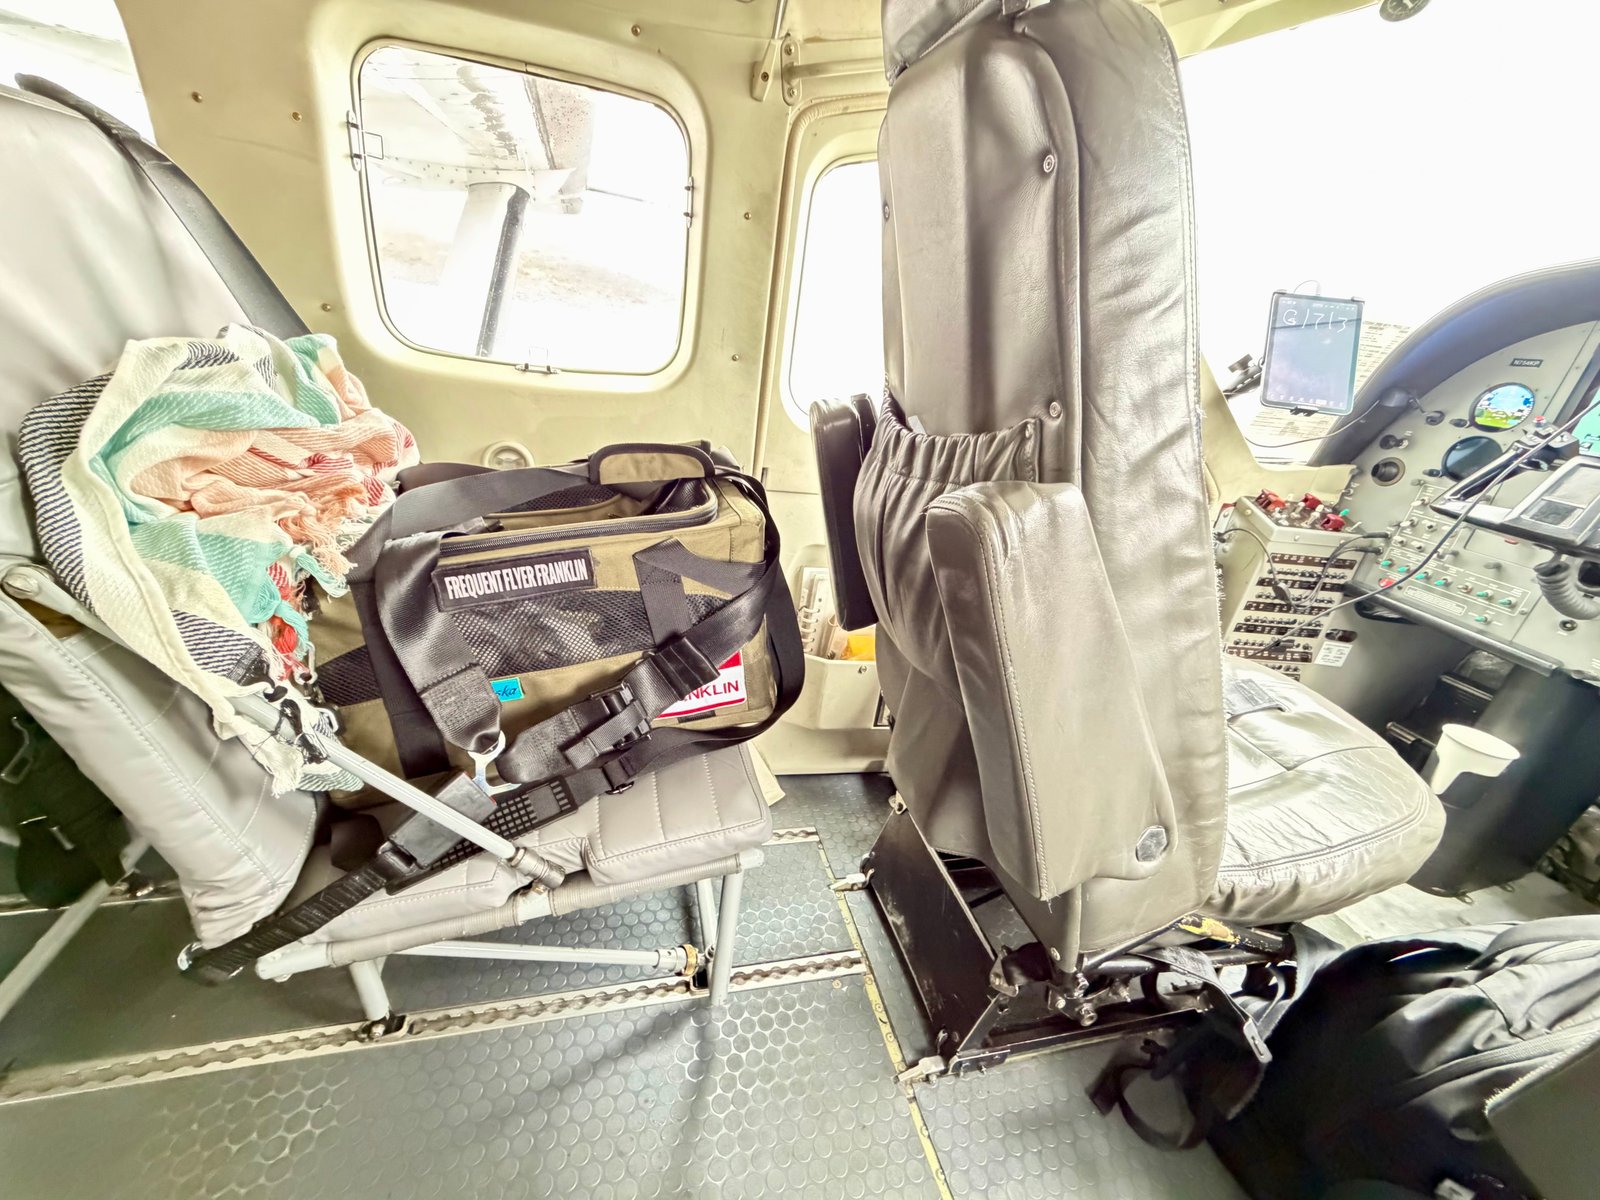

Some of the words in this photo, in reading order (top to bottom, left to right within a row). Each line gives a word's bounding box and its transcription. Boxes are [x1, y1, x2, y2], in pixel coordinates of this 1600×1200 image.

[444, 569, 503, 599] FREQUENT
[503, 565, 537, 592] FLYER
[536, 558, 588, 587] FRANKLIN
[684, 680, 739, 702] NKLIN
